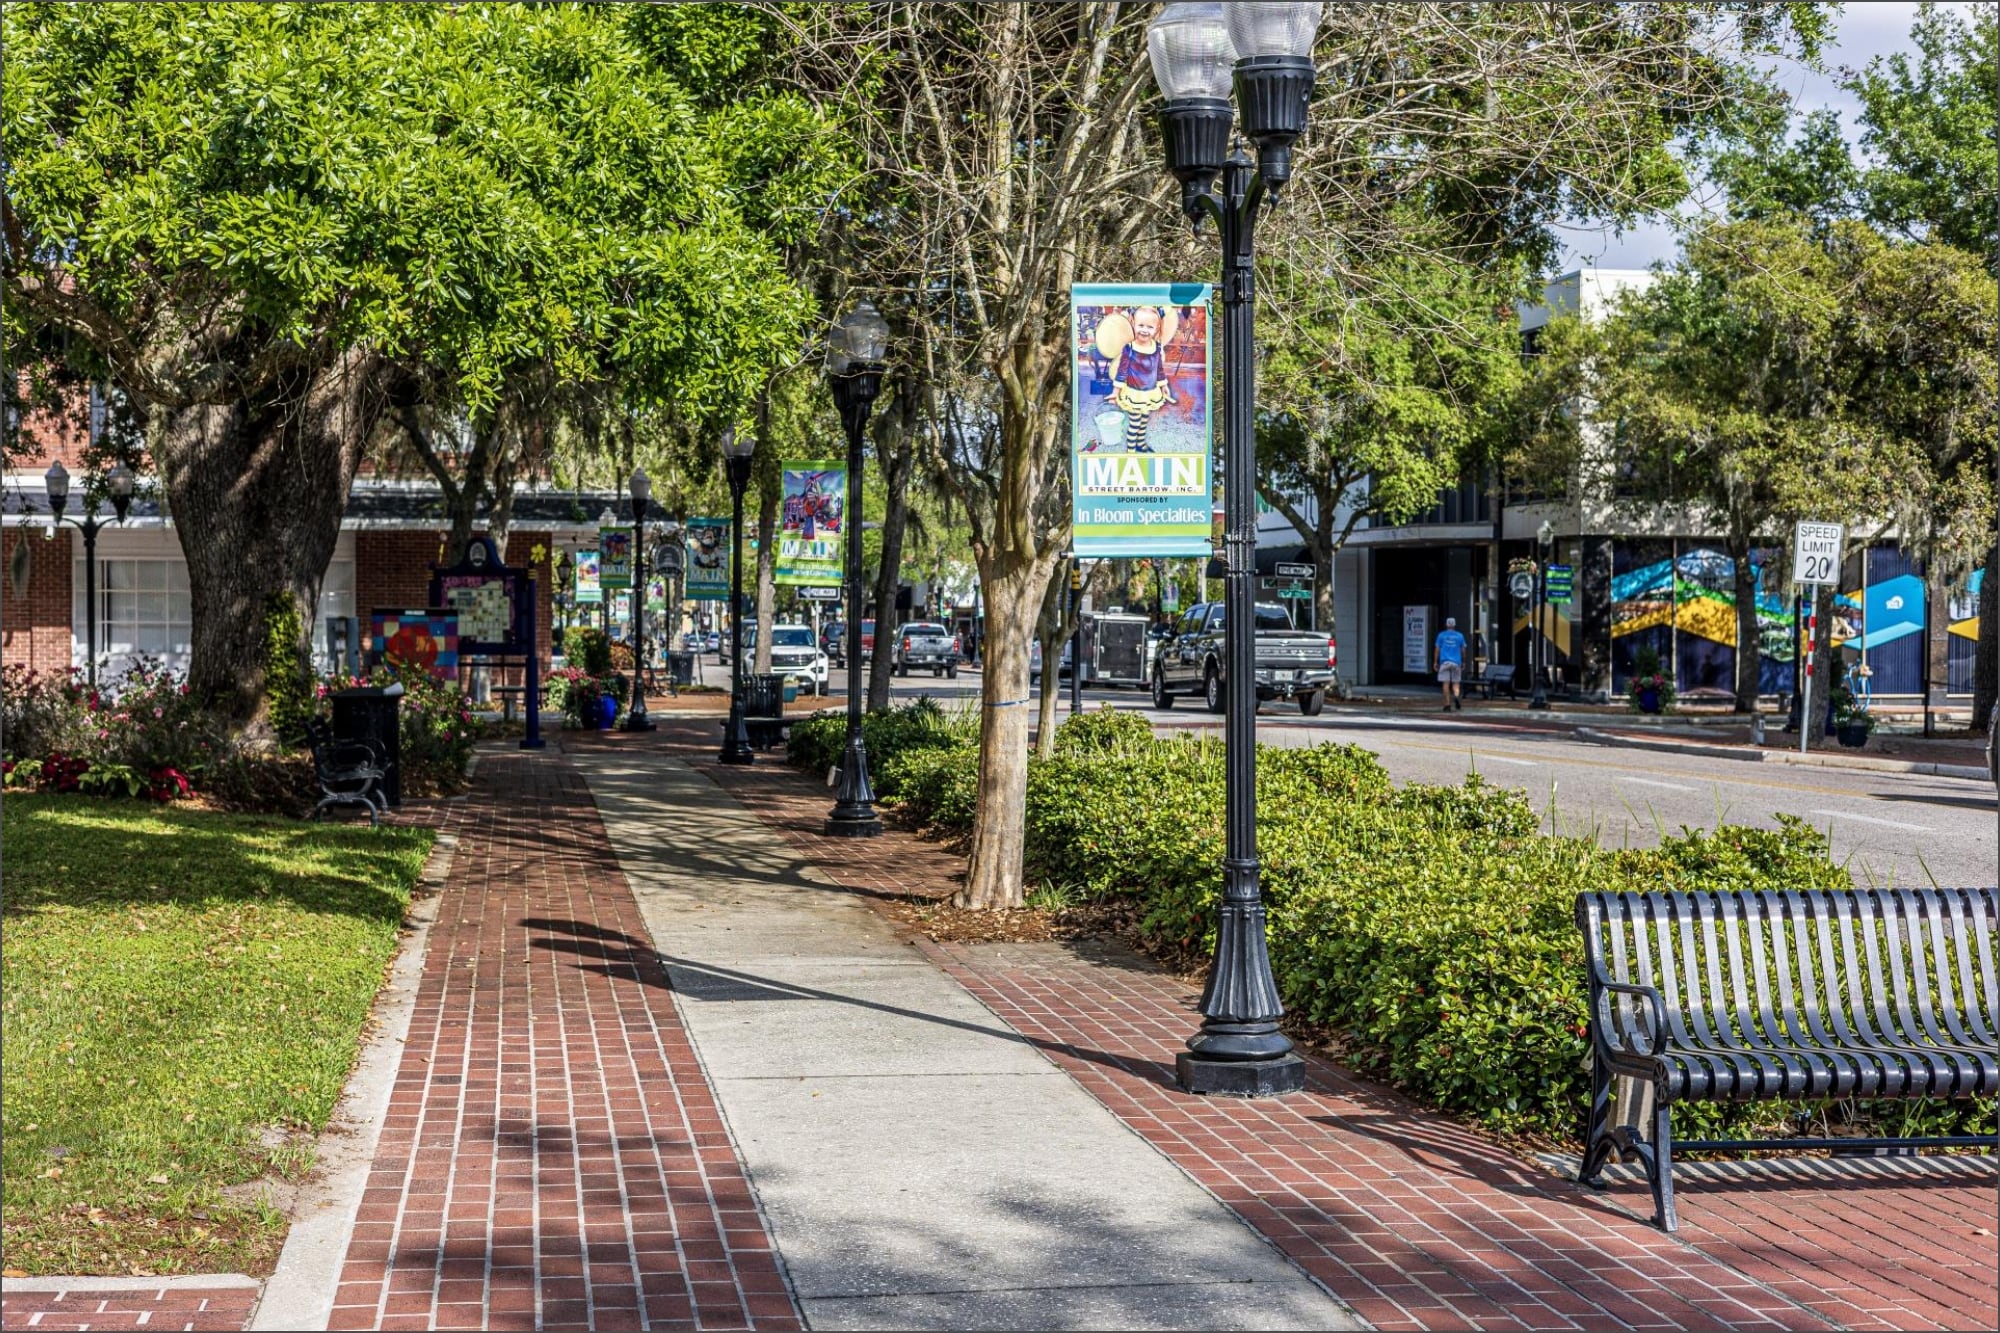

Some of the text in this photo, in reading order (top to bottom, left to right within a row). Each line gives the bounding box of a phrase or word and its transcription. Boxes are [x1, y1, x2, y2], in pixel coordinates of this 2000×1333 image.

[1086, 457, 1198, 486] MAIN
[1078, 508, 1206, 525] In Bloom Specialties
[1800, 525, 1838, 539] SPEED
[783, 541, 838, 556] MAIN
[1802, 541, 1835, 553] LIMIT
[690, 569, 725, 582] MAIN
[1804, 556, 1829, 580] 20
